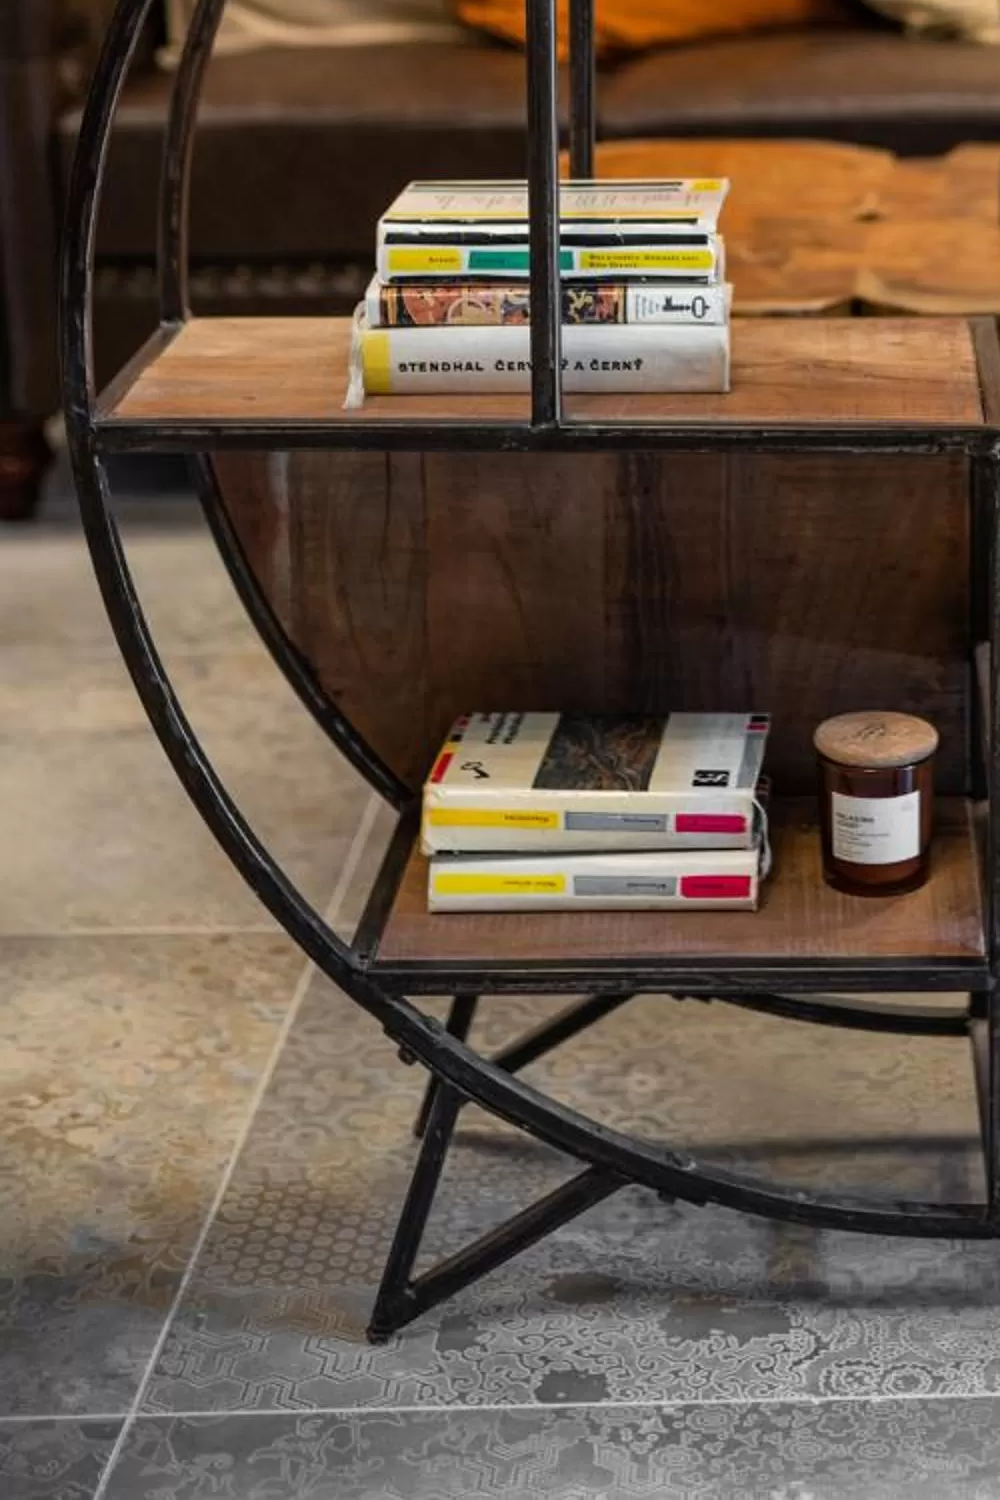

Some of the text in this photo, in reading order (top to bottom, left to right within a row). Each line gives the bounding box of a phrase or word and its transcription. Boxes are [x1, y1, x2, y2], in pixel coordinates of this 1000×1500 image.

[398, 357, 644, 373] STENDHAL ČERVÝ A ČERNÝ
